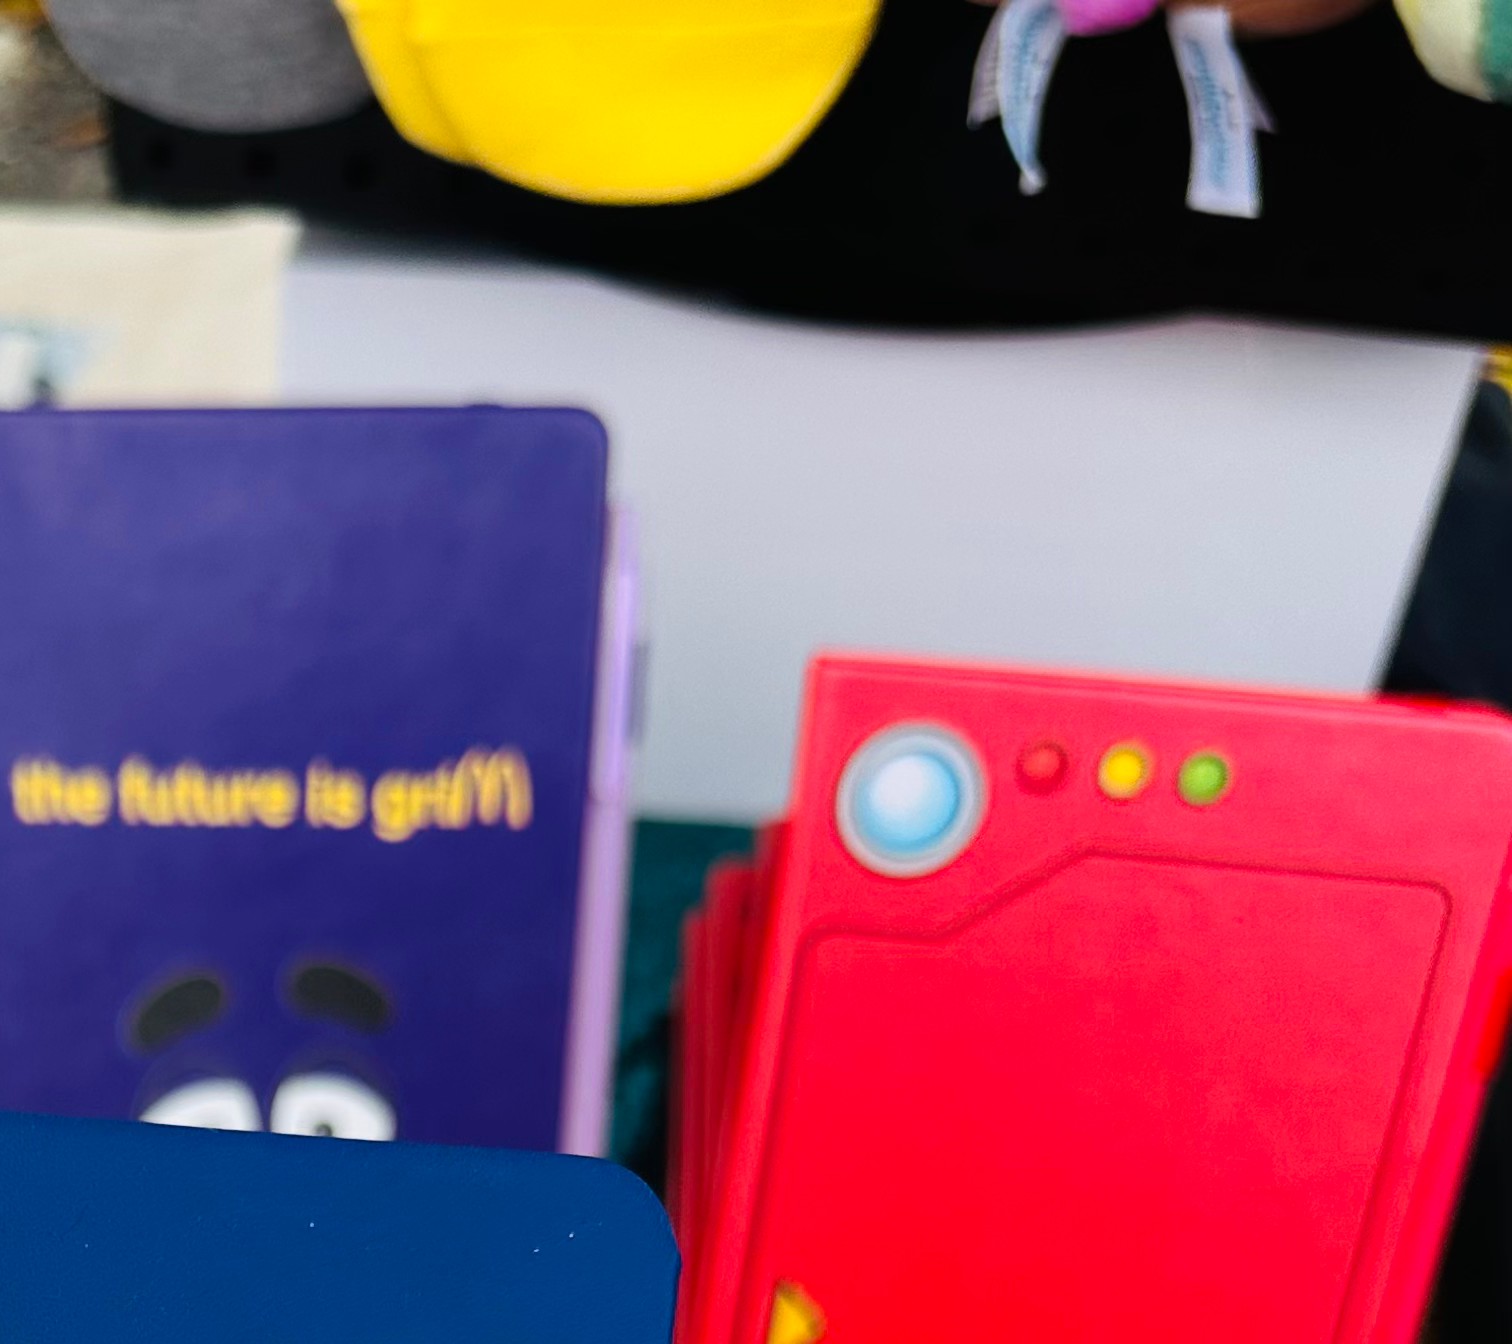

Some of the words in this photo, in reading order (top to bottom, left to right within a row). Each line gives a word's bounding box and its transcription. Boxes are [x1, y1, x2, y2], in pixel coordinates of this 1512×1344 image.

[11, 753, 112, 826] the
[118, 753, 299, 828] future
[304, 757, 366, 829] is
